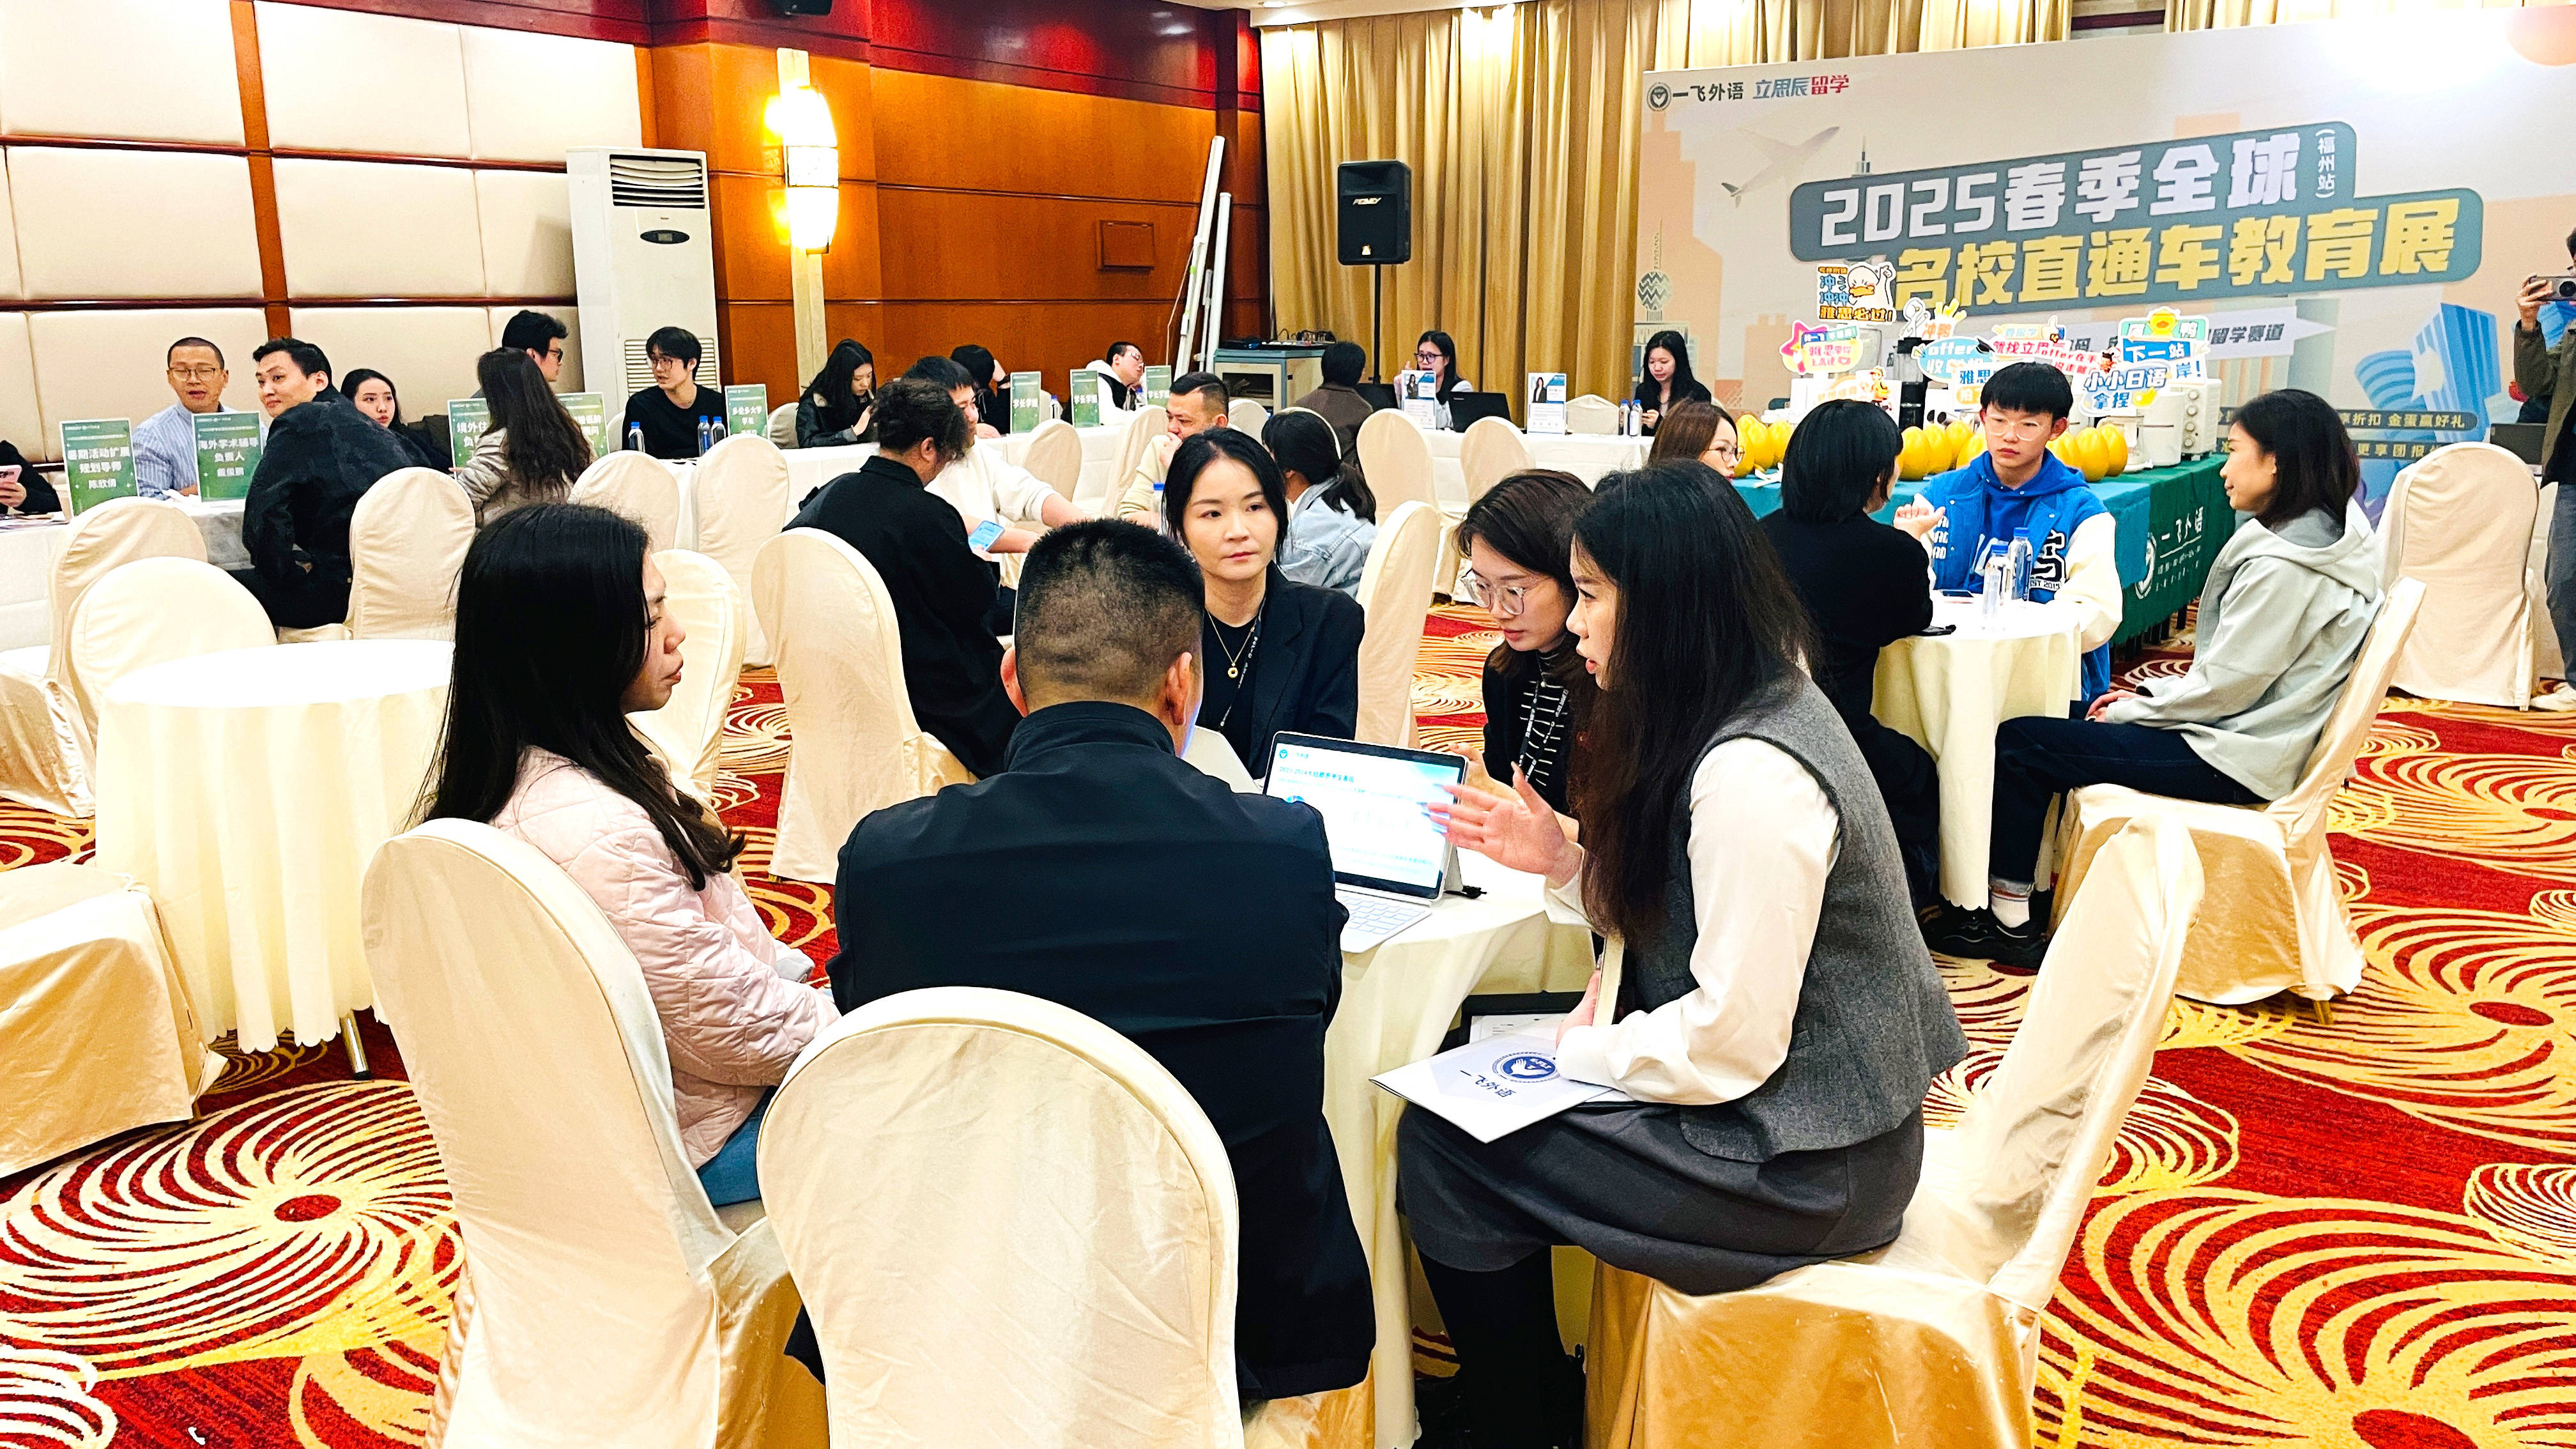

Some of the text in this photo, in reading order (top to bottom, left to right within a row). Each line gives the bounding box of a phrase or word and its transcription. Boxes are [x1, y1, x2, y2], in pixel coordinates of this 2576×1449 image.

[1673, 82, 1744, 102] 一飞外语
[1752, 74, 1849, 99] 立思辰留学
[1820, 132, 2300, 247] 2025春季全球
[1894, 198, 2460, 310] 名校直通车教育展
[2209, 323, 2285, 344] 留学赛道
[1928, 342, 1975, 355] offer
[2126, 343, 2184, 362] 下一站
[1959, 369, 1999, 385] 雅思
[2084, 367, 2168, 392] 小小日语
[2093, 392, 2130, 409] 拿捏
[2388, 413, 2465, 428] 金蛋赢好礼
